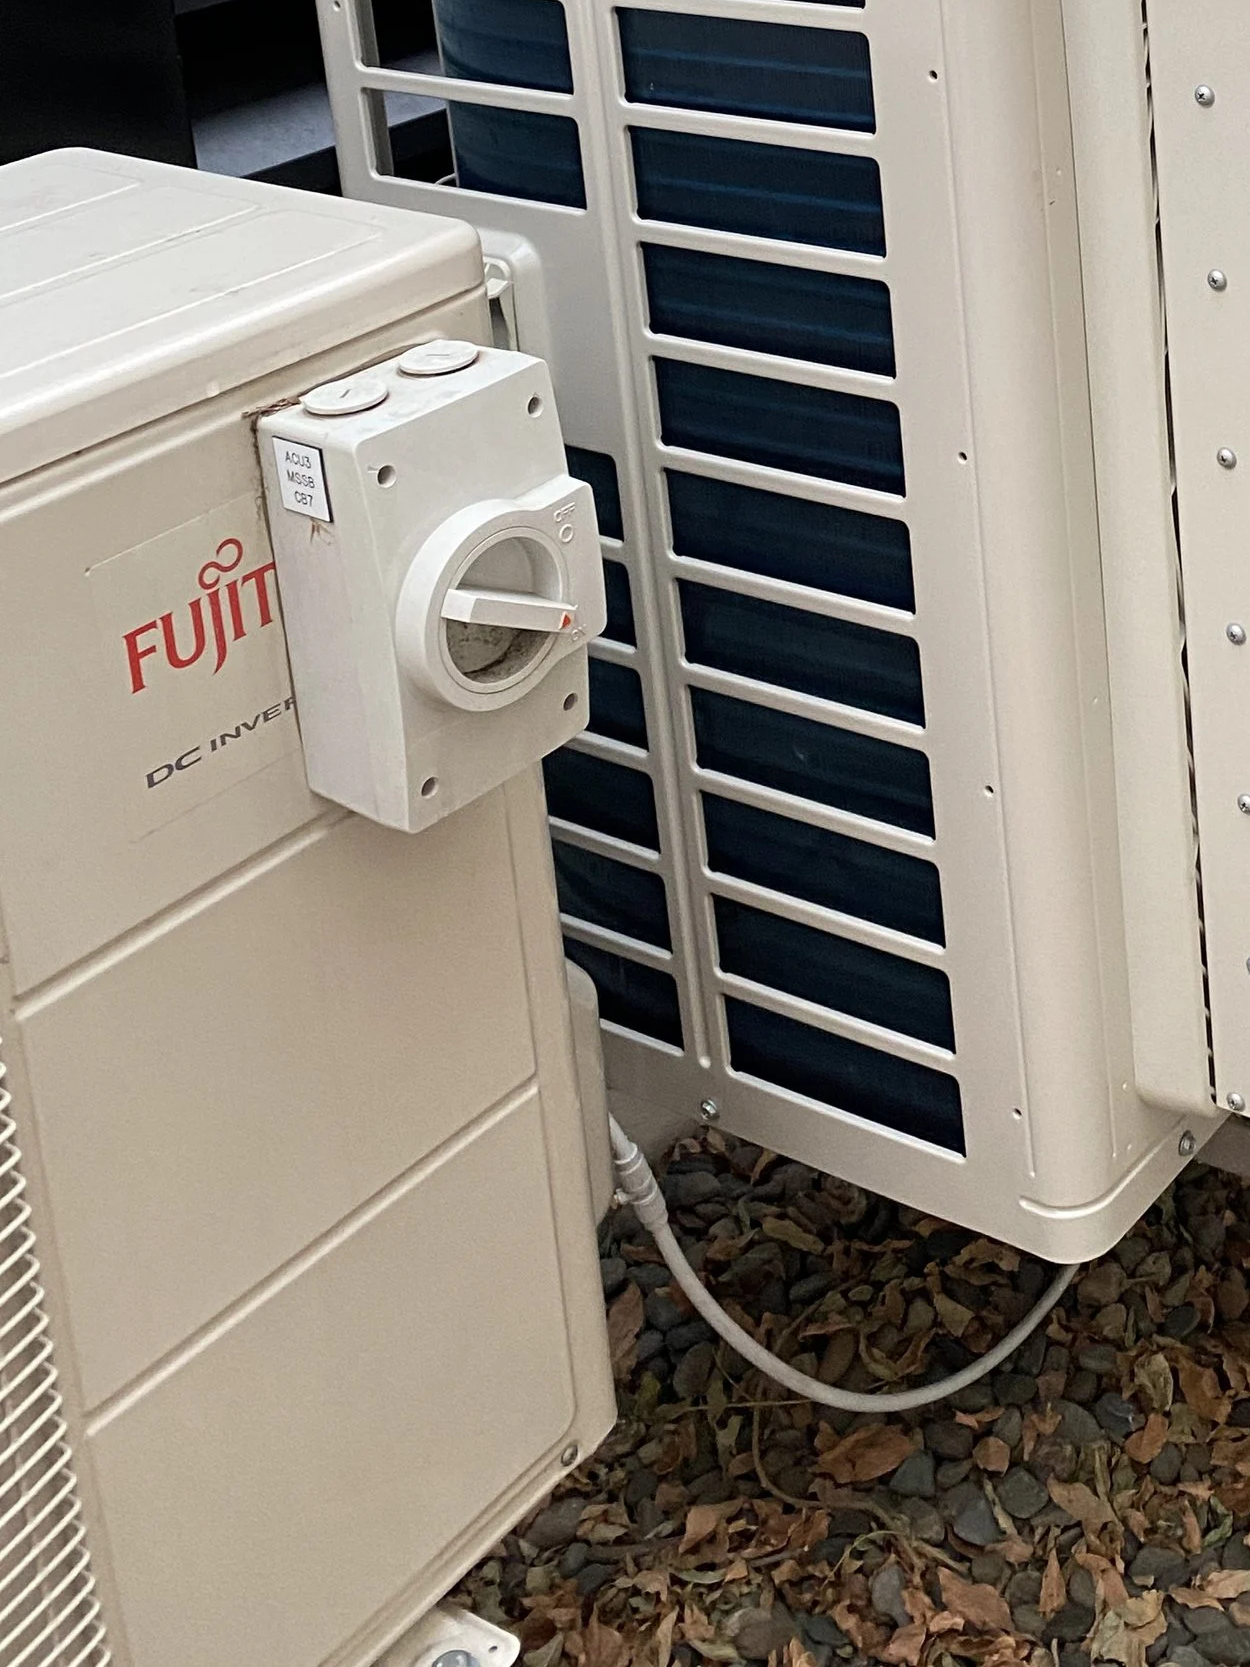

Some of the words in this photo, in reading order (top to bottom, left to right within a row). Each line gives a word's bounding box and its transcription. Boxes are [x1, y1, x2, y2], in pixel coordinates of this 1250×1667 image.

[285, 451, 312, 469] ACU3
[553, 501, 576, 523] OFF
[145, 745, 202, 789] DC
